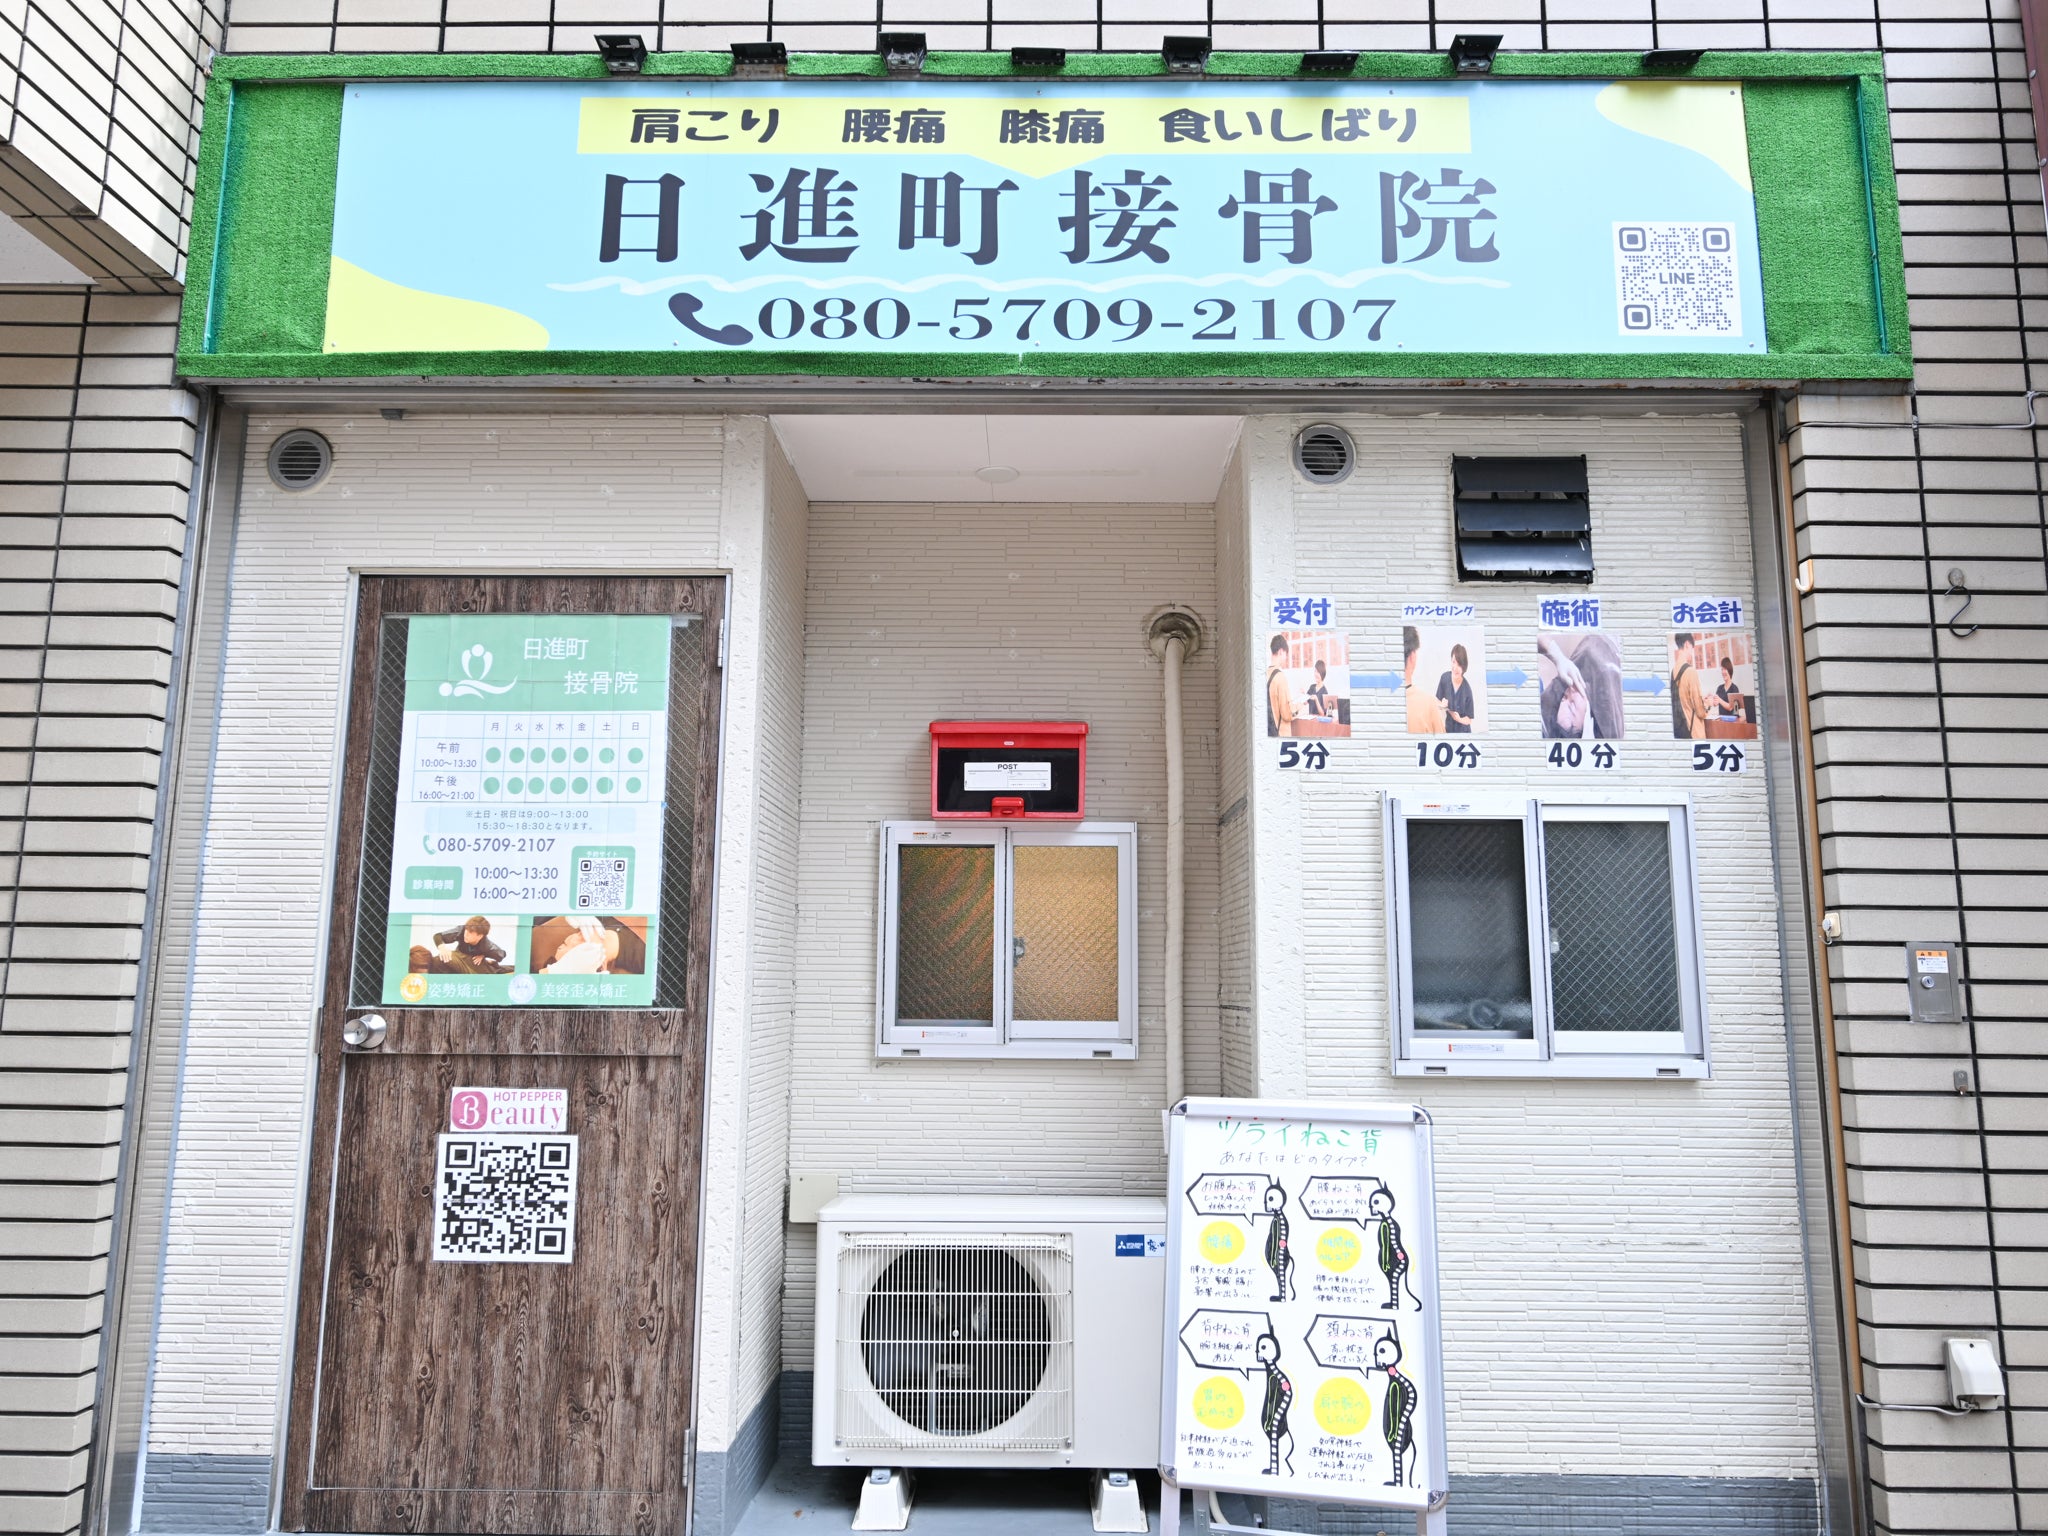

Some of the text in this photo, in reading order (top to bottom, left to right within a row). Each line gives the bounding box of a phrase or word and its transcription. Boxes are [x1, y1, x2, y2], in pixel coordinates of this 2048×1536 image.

[630, 108, 1417, 144] 肩こり 腰痛 膝痛 食いしばり
[599, 167, 1501, 265] 日進町接骨院
[1659, 272, 1695, 285] LINE
[758, 297, 1397, 342] 080-5709-2107
[1273, 597, 1331, 626] 受付
[1404, 605, 1474, 616] カウンセリング
[1541, 599, 1599, 627] 施術
[1672, 600, 1742, 624] お会計
[523, 637, 589, 660] 日進町
[564, 671, 639, 695] 接骨院
[490, 722, 640, 732] 月 火 水 木 金 土 日
[437, 742, 461, 754] 午前
[1279, 741, 1330, 770] 5分
[1417, 742, 1481, 769] 10分
[1548, 742, 1617, 769] 40分
[1693, 743, 1744, 772] 5分
[434, 775, 458, 787] 午後
[438, 837, 556, 853] 080-5709-2107
[428, 983, 486, 998] 姿勢矯正
[541, 983, 628, 999] 美容歪み矯正
[493, 1091, 562, 1102] HOT PEPPER
[456, 1094, 564, 1129] Beauty
[1218, 1120, 1383, 1156] ツライねこ背
